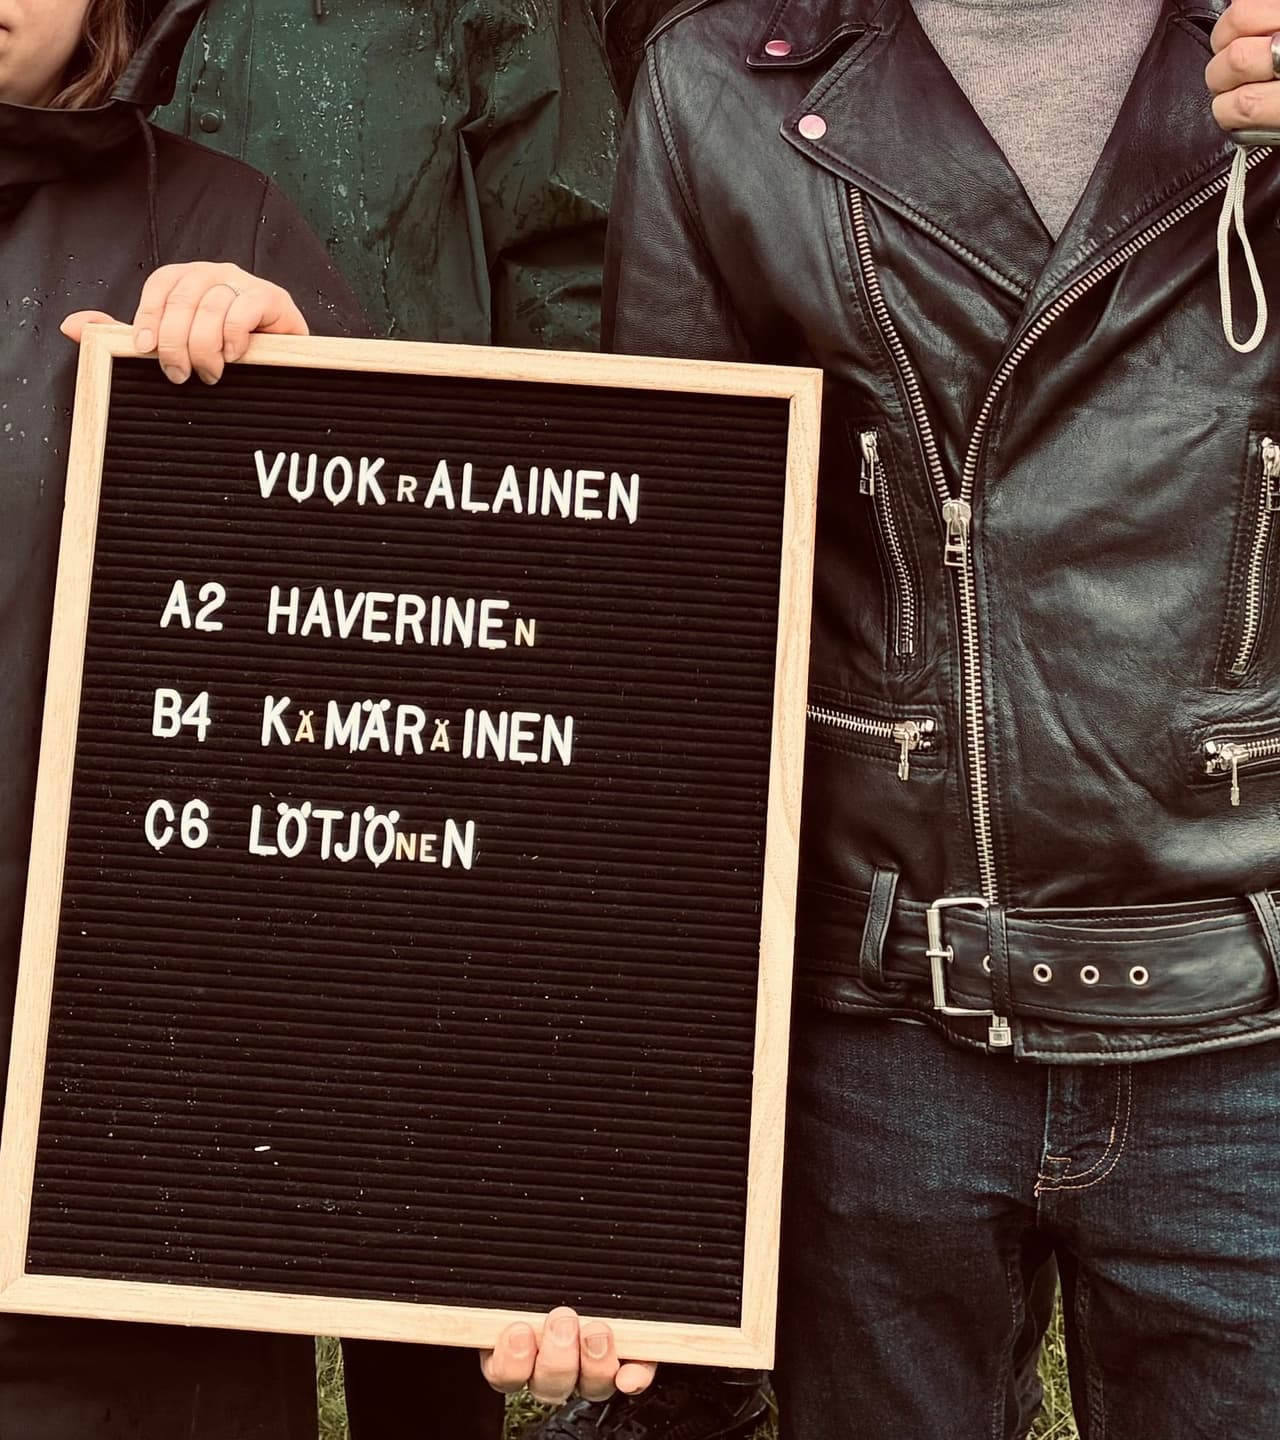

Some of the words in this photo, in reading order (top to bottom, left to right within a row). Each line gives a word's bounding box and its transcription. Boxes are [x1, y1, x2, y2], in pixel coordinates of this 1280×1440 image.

[254, 449, 640, 525] VUOKRALAINEN
[159, 579, 226, 632] A2
[267, 585, 537, 650] HAVERINEN
[152, 687, 212, 742] B4
[261, 695, 574, 766] KÄMÄRÄINEN
[144, 798, 210, 851] C6
[248, 801, 476, 870] LÖTJÖNEN
